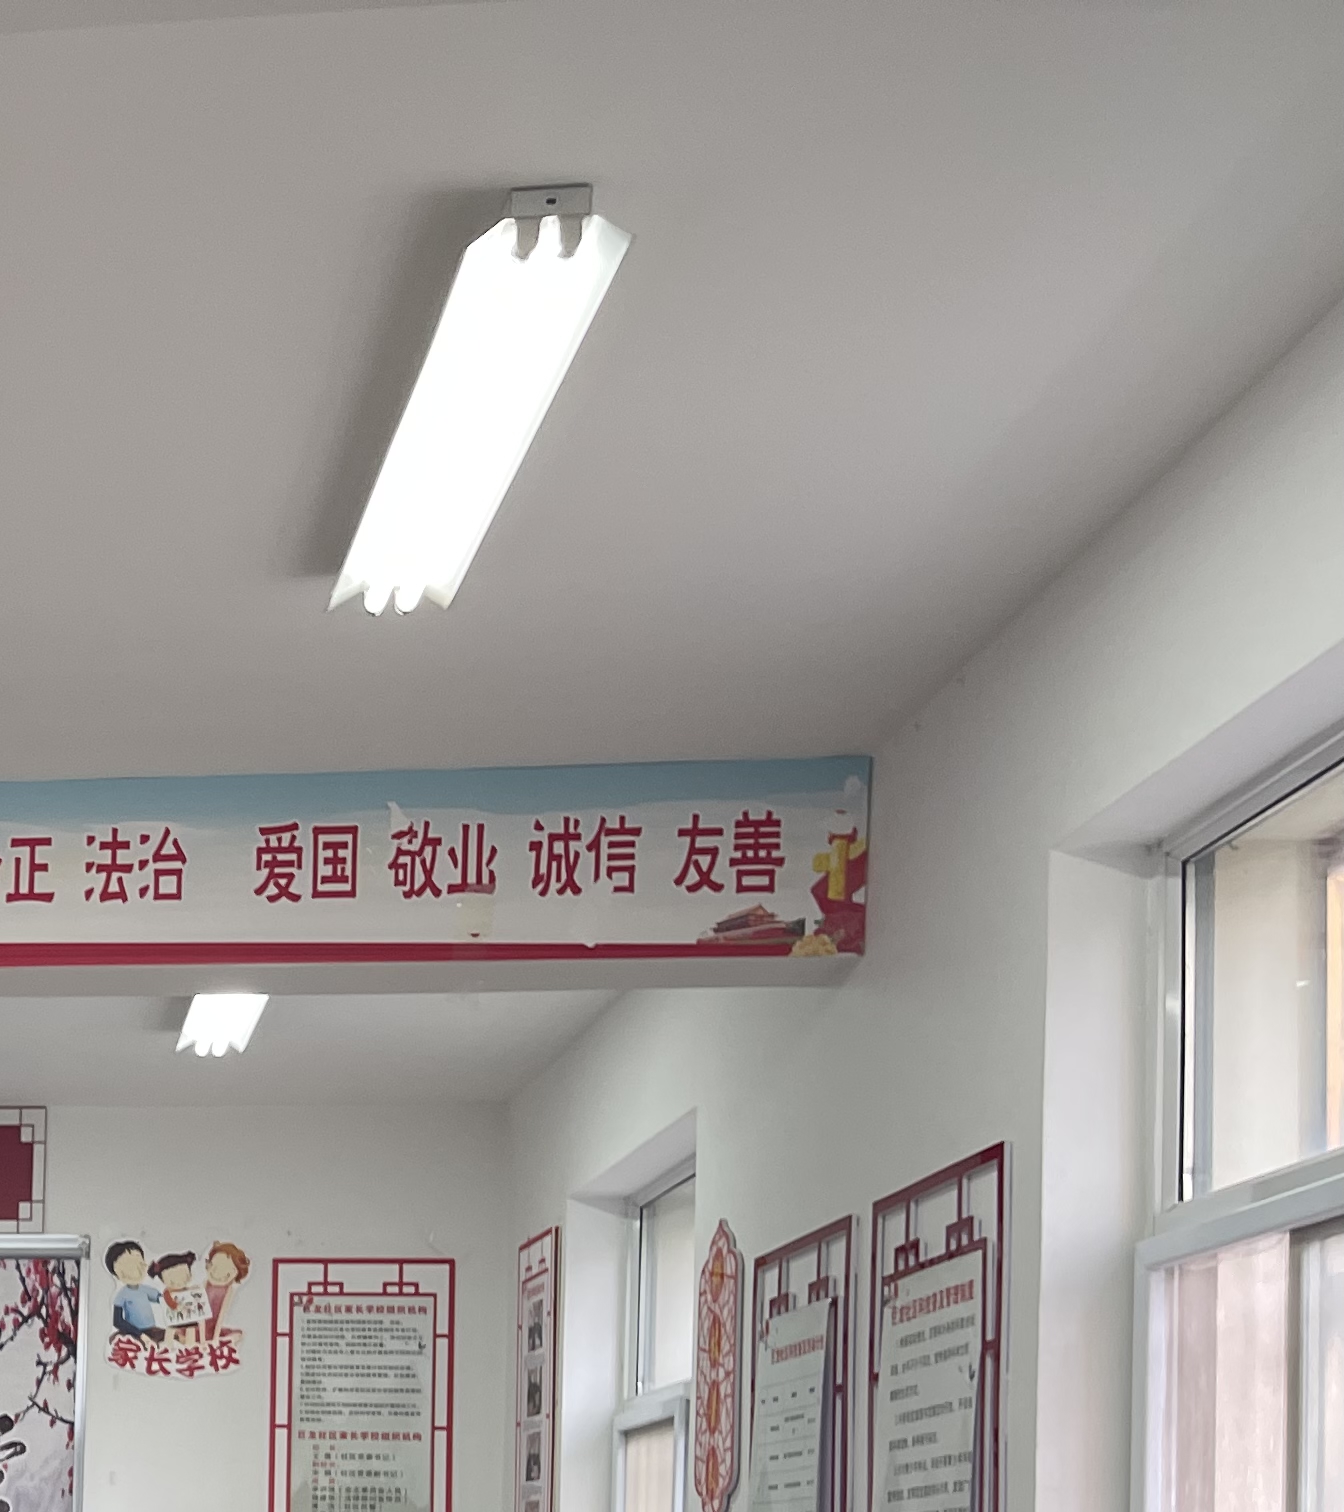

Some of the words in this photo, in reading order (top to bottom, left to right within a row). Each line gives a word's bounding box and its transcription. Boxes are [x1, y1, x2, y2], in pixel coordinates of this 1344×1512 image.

[82, 827, 190, 904] 法治
[253, 822, 360, 903] 爱国
[387, 816, 500, 902] 敬业
[528, 813, 644, 899] 诚信
[673, 809, 788, 896] 友善
[108, 1339, 241, 1378] 家长学校
